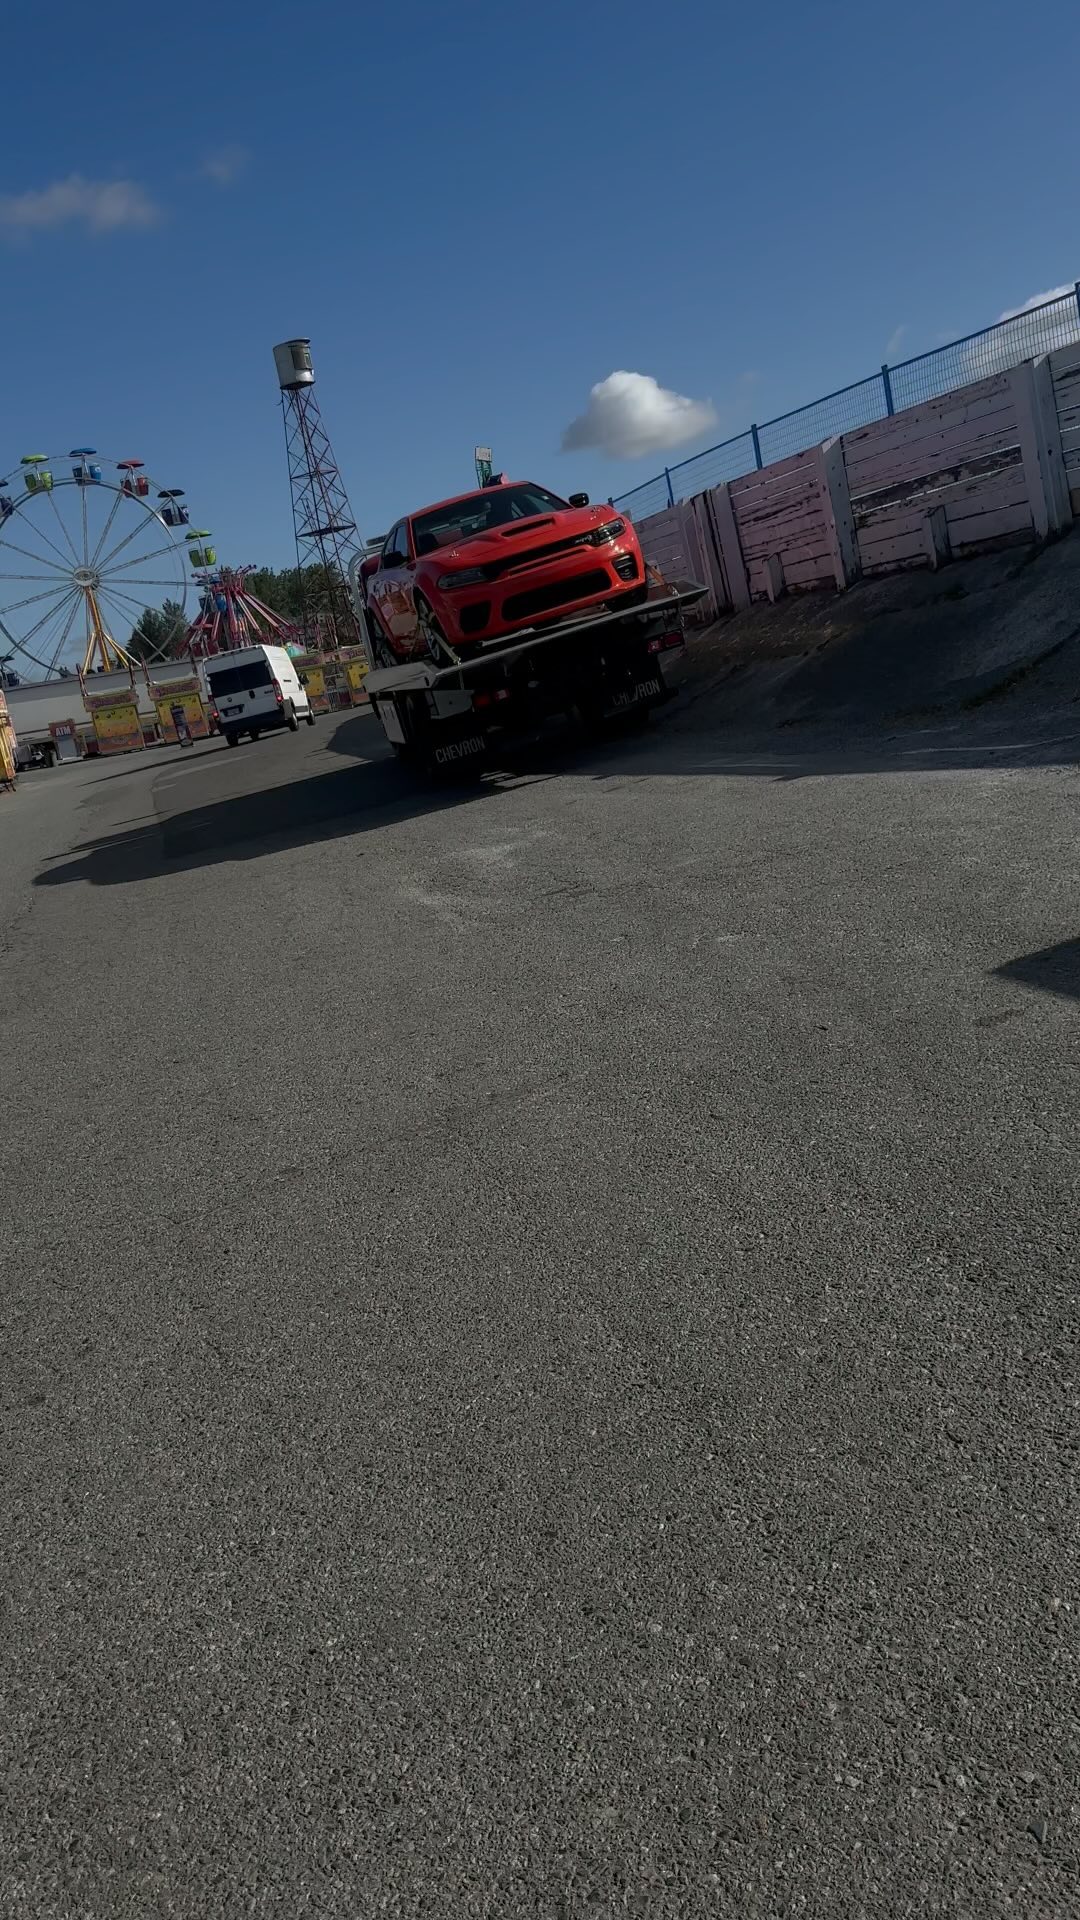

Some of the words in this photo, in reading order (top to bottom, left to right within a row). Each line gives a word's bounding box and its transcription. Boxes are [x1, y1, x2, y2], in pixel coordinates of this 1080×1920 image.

[611, 678, 660, 705] CHVRON
[56, 725, 71, 737] ATM
[435, 735, 486, 763] CHEVRON
